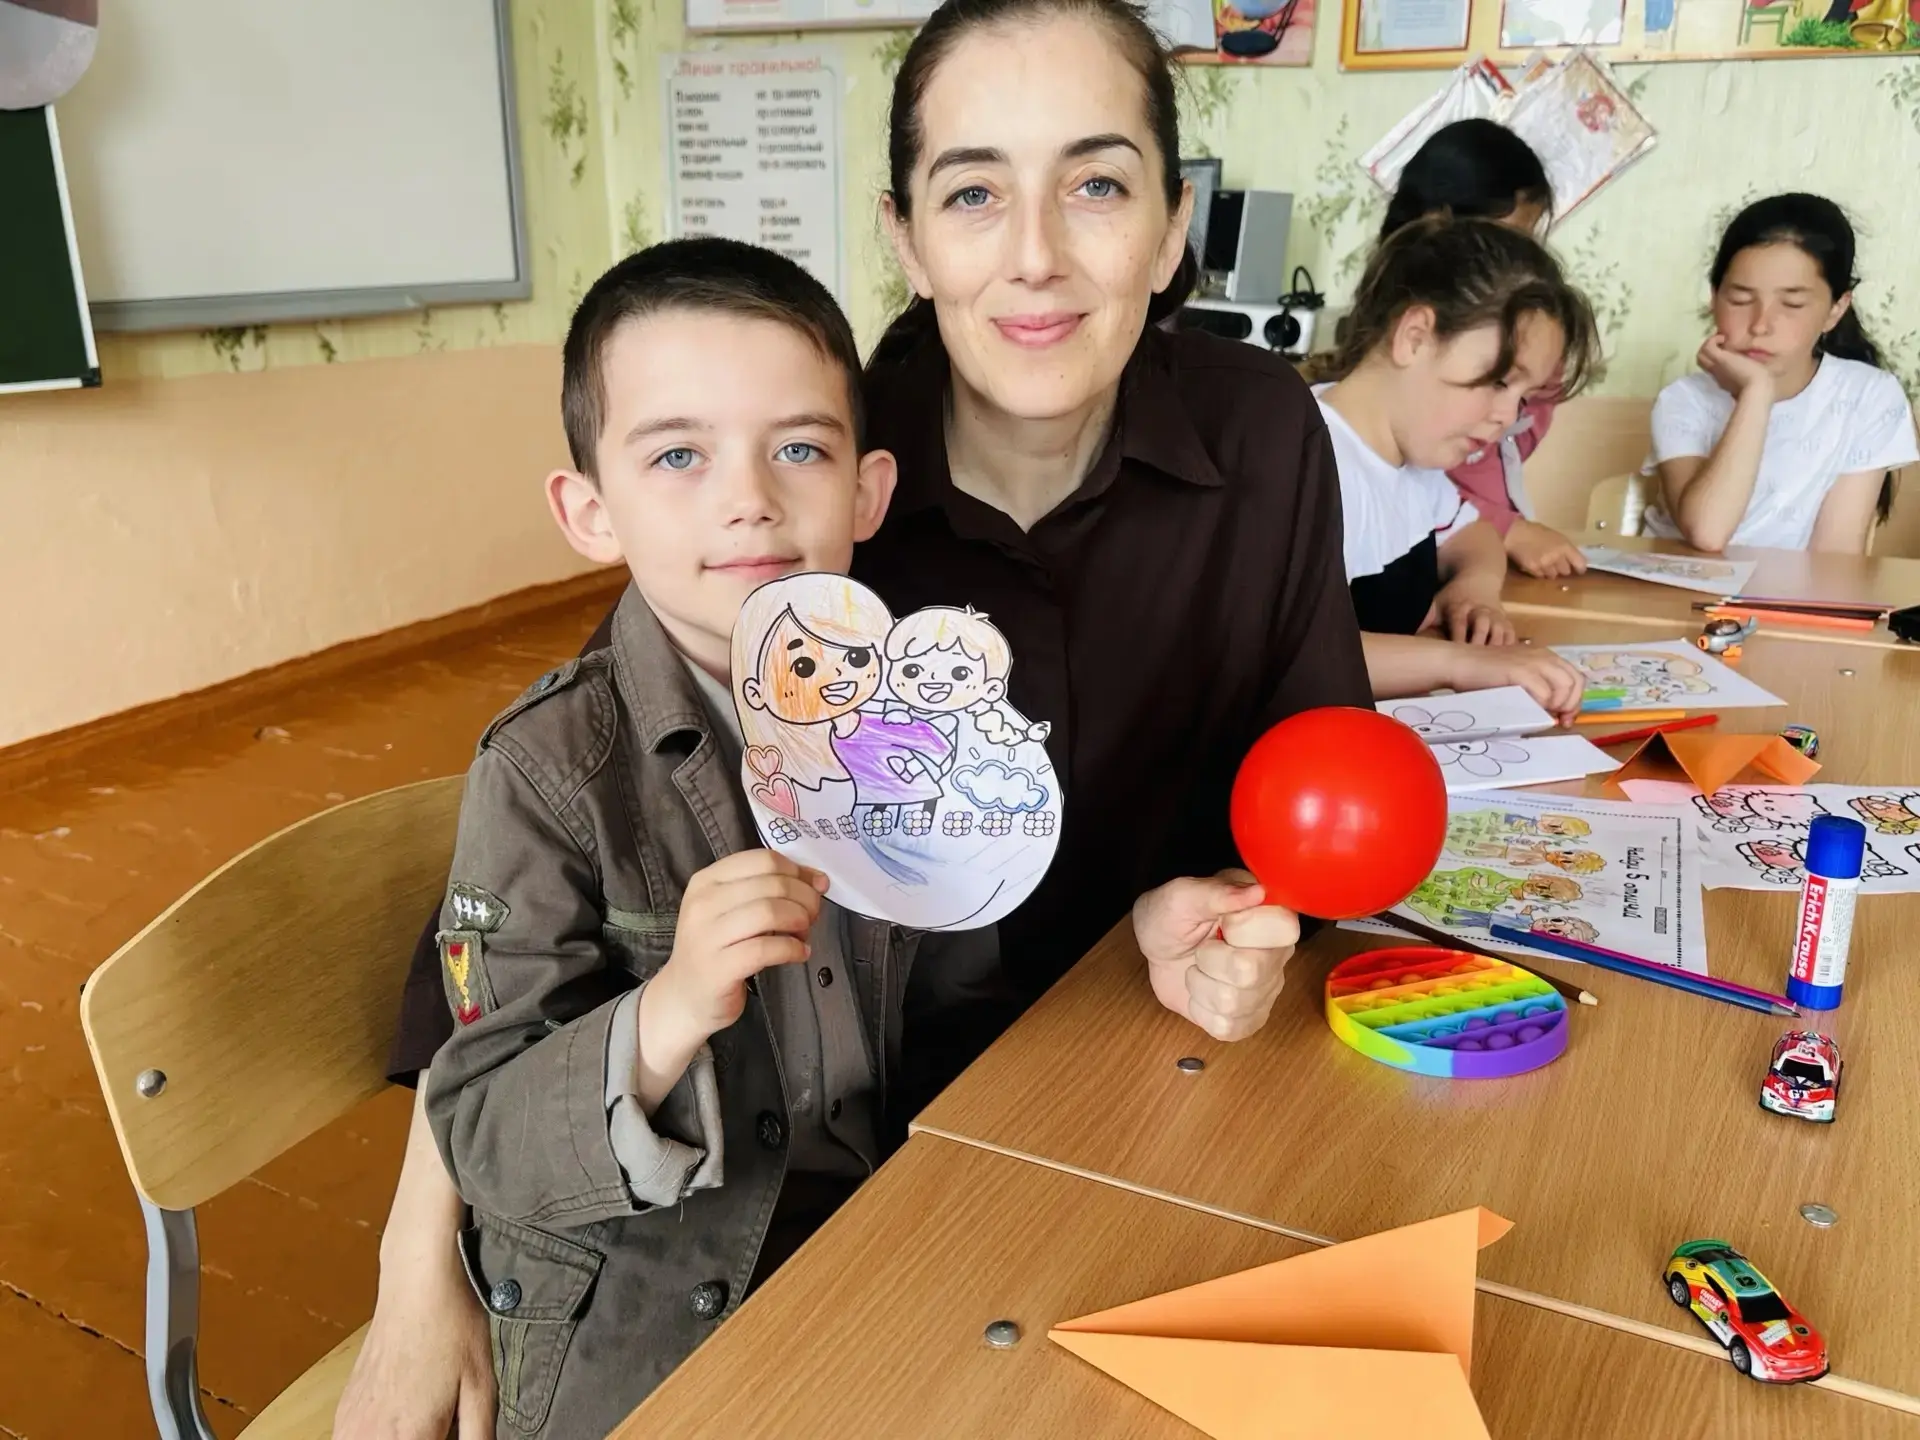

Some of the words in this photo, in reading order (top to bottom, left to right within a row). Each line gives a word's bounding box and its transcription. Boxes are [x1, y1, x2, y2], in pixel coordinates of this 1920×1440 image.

[1618, 846, 1645, 870] Найди
[1621, 883, 1643, 919] отличий
[1796, 882, 1824, 978] ErichKrause
